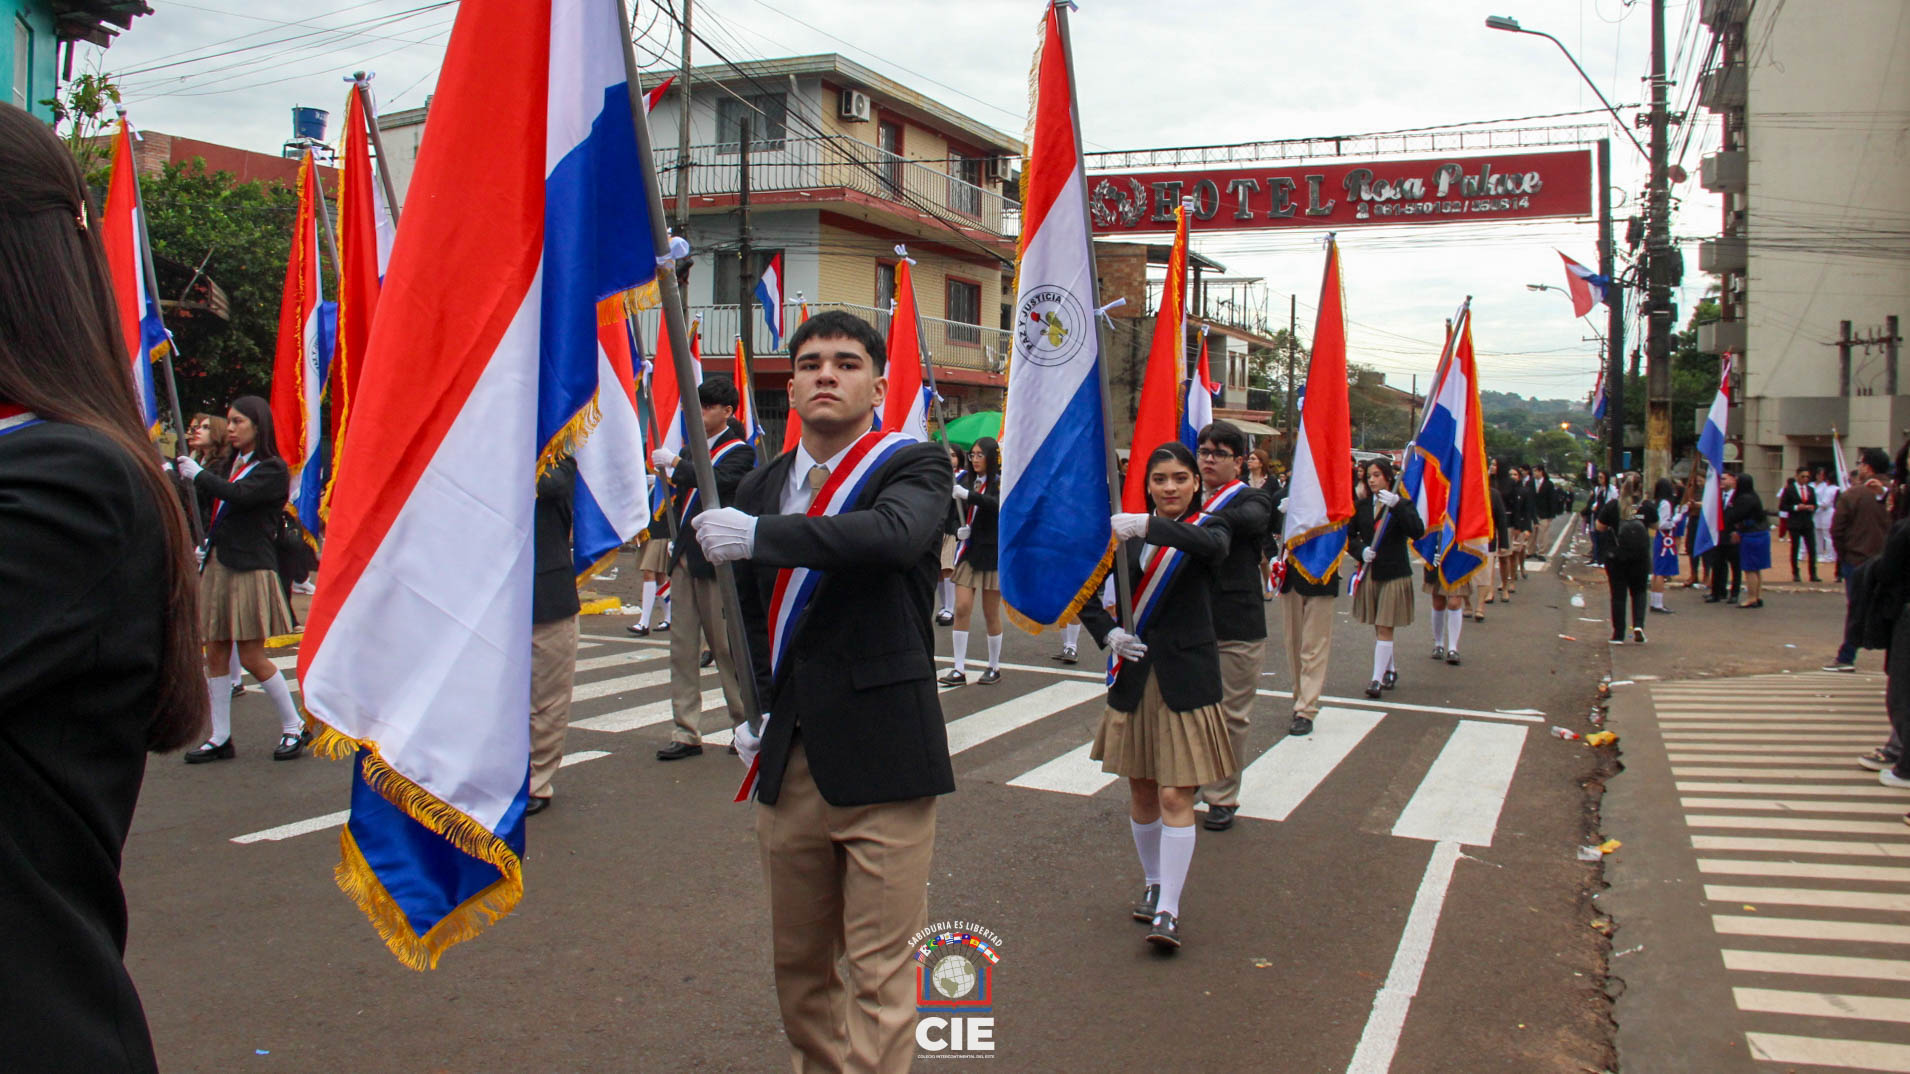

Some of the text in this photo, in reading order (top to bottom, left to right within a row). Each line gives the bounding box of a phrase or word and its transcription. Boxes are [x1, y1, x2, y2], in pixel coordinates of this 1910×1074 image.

[1343, 163, 1543, 202] Rosa Palace
[1151, 175, 1336, 222] HOTEL
[1022, 293, 1062, 317] JUSTICIA
[1020, 330, 1033, 351] PAZ
